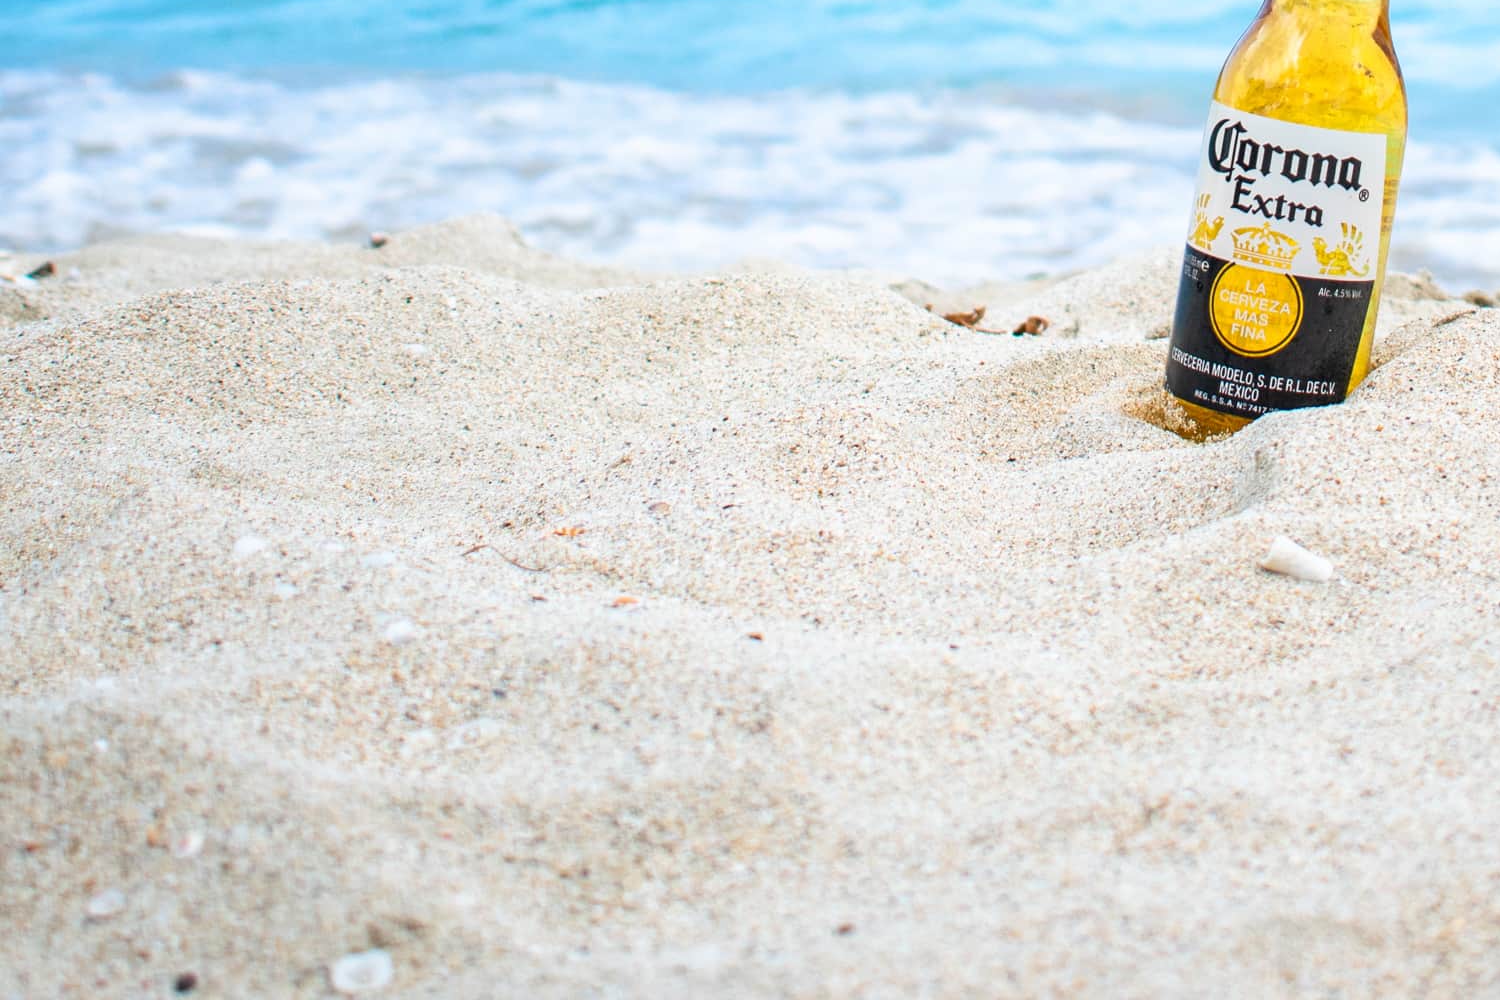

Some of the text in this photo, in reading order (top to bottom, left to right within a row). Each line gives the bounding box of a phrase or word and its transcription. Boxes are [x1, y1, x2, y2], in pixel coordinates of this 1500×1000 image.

[1208, 118, 1361, 191] Corona
[1231, 174, 1323, 227] Extra
[1245, 279, 1266, 296] LA
[1318, 287, 1332, 297] Alc.
[1219, 288, 1291, 315] CERVEZA
[1234, 308, 1269, 327] MAS
[1231, 322, 1267, 342] FINA
[1172, 346, 1336, 396] CERVECERIA MODELO, S. DE R.L. DE C.V.
[1219, 381, 1260, 402] MEXICO
